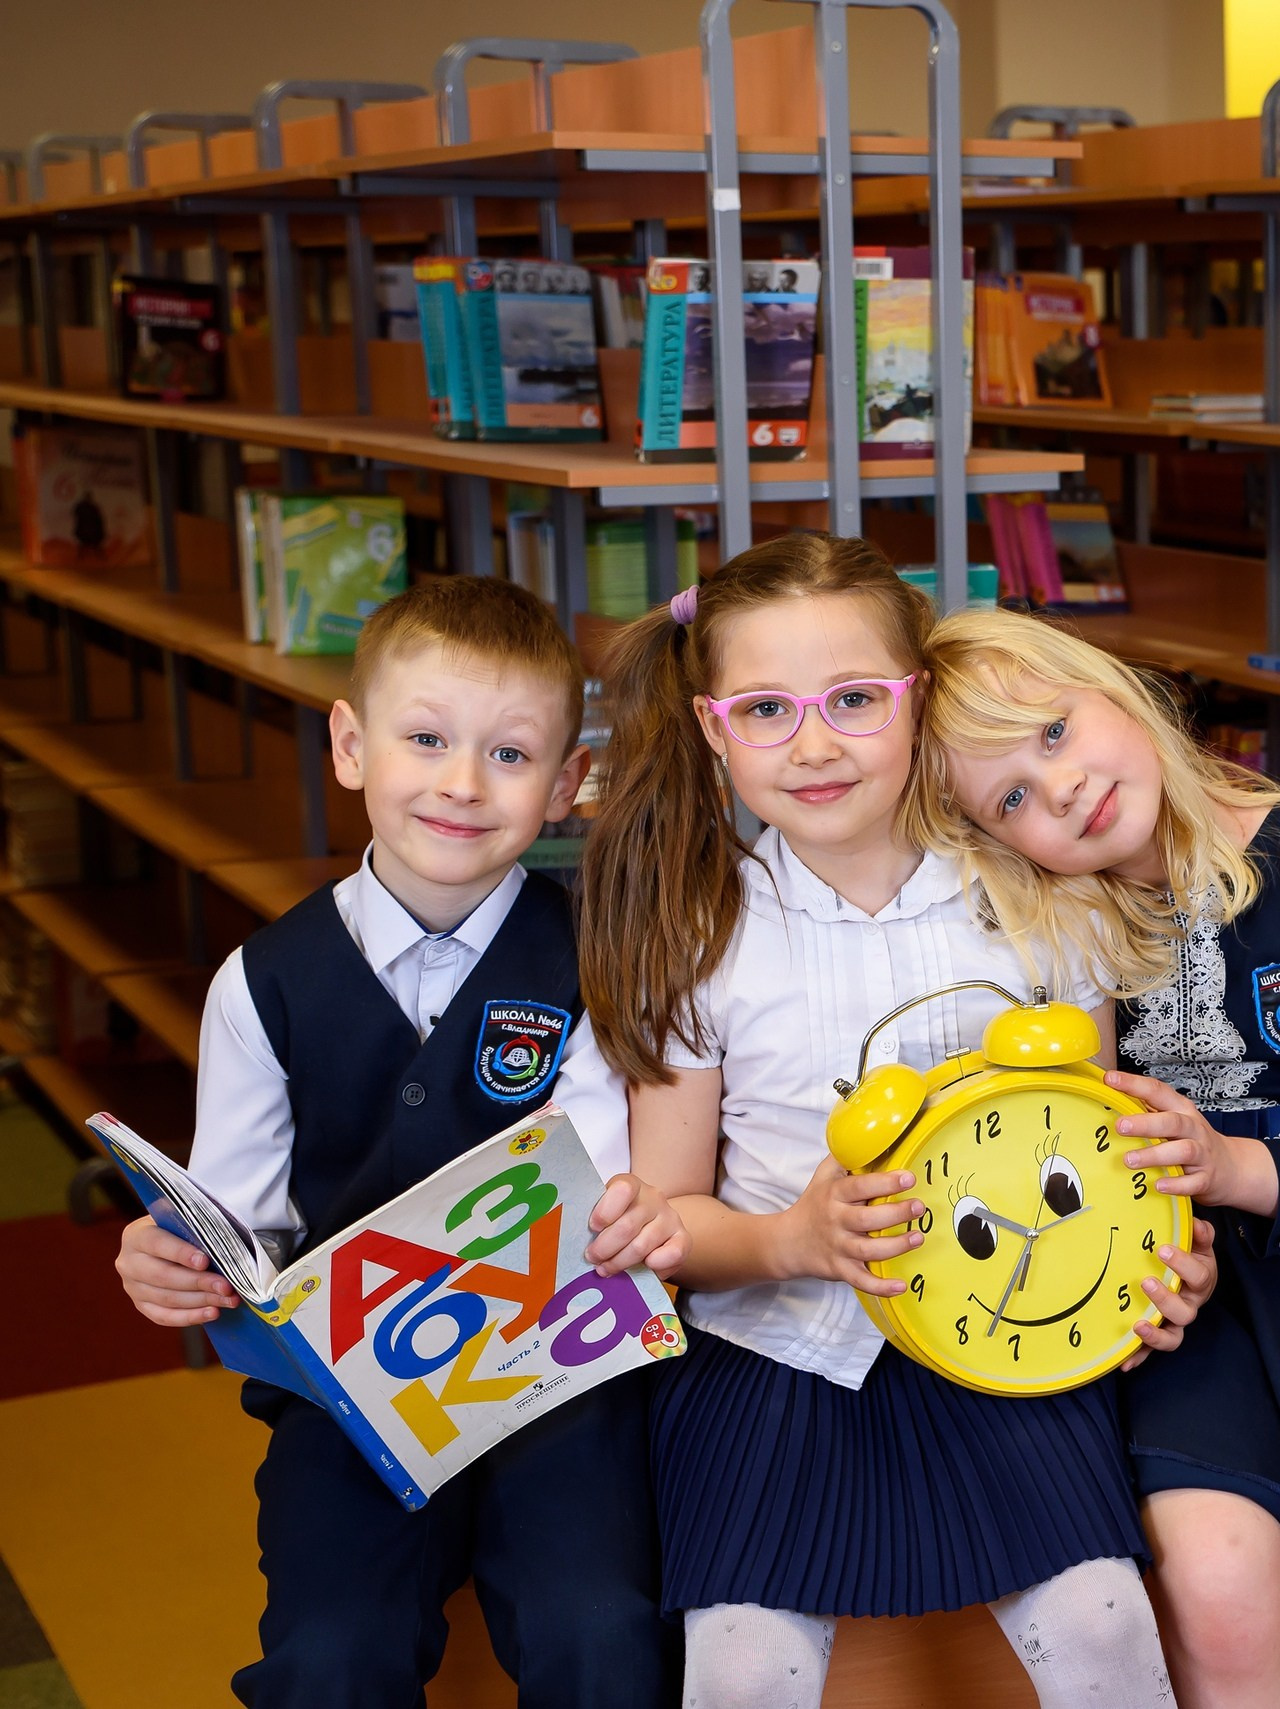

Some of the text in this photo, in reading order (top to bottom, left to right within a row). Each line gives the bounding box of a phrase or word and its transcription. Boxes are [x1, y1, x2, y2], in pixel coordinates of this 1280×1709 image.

[658, 301, 682, 443] ЛИТЕРАТУРА
[581, 407, 600, 428] 6
[752, 424, 774, 446] 6
[368, 523, 395, 563] 6
[490, 1010, 563, 1030] ШКОЛА №46
[490, 1076, 540, 1094] начинается
[538, 1053, 552, 1077] здесь
[973, 1110, 1002, 1145] 12
[1043, 1105, 1051, 1130] 1
[1095, 1125, 1111, 1153] 2
[924, 1151, 950, 1186] 11
[1132, 1171, 1147, 1200] 3
[1142, 1229, 1156, 1254] 4
[910, 1273, 926, 1303] 9
[1117, 1284, 1131, 1312] 5
[645, 1323, 660, 1333] CD
[955, 1315, 969, 1346] 8
[1068, 1321, 1082, 1348] 6
[532, 1340, 541, 1349] 2
[1007, 1333, 1021, 1362] 7
[516, 1376, 570, 1410] ПРОСВЕЩЕНИЕ
